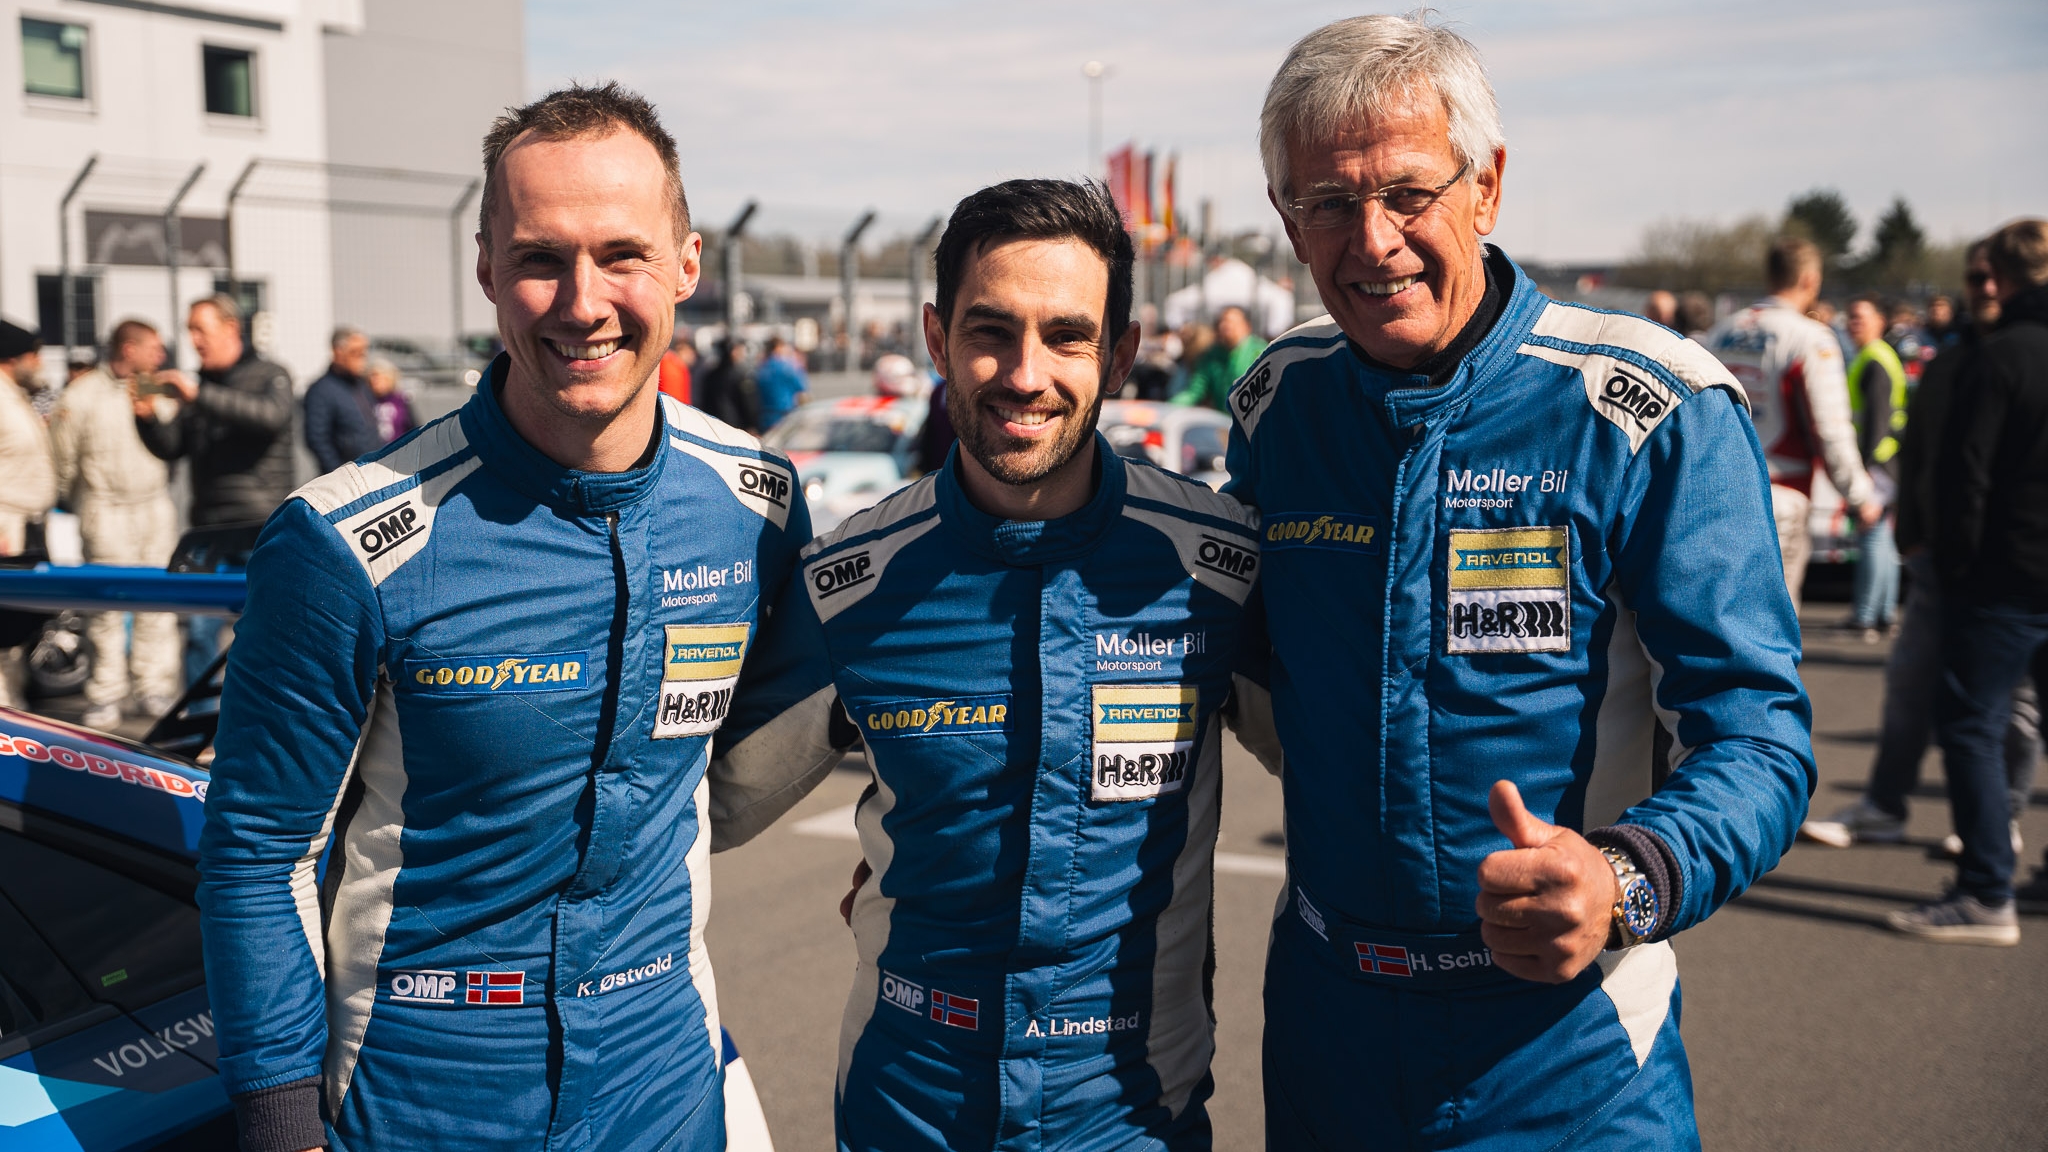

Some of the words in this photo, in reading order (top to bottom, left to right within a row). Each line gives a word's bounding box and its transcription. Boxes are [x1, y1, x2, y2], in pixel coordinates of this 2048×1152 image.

[1238, 367, 1271, 413] OMP
[1605, 375, 1662, 420] OMP
[740, 469, 789, 500] OMP
[1540, 469, 1567, 493] Bil
[1445, 496, 1513, 511] Motorsport
[360, 507, 416, 553] OMP
[734, 558, 752, 585] Bil
[1198, 541, 1256, 576] OMP
[1465, 552, 1552, 567] RAVENOL
[815, 555, 871, 592] OMP
[661, 592, 718, 607] Motorsport
[1454, 602, 1527, 638] H&R
[677, 646, 738, 660] RAVENOL
[1183, 630, 1206, 655] Bil
[1096, 660, 1162, 672] Motorsport
[660, 691, 714, 726] H&R
[1108, 708, 1186, 720] RAVENOL
[1098, 754, 1161, 788] H&R
[577, 980, 596, 998] K.
[600, 952, 672, 993] Østvold
[1410, 952, 1434, 971] H.
[391, 973, 457, 999] OMP
[882, 977, 925, 1009] OMP
[1024, 1019, 1047, 1038] A.
[1049, 1011, 1140, 1036] Lindstad
